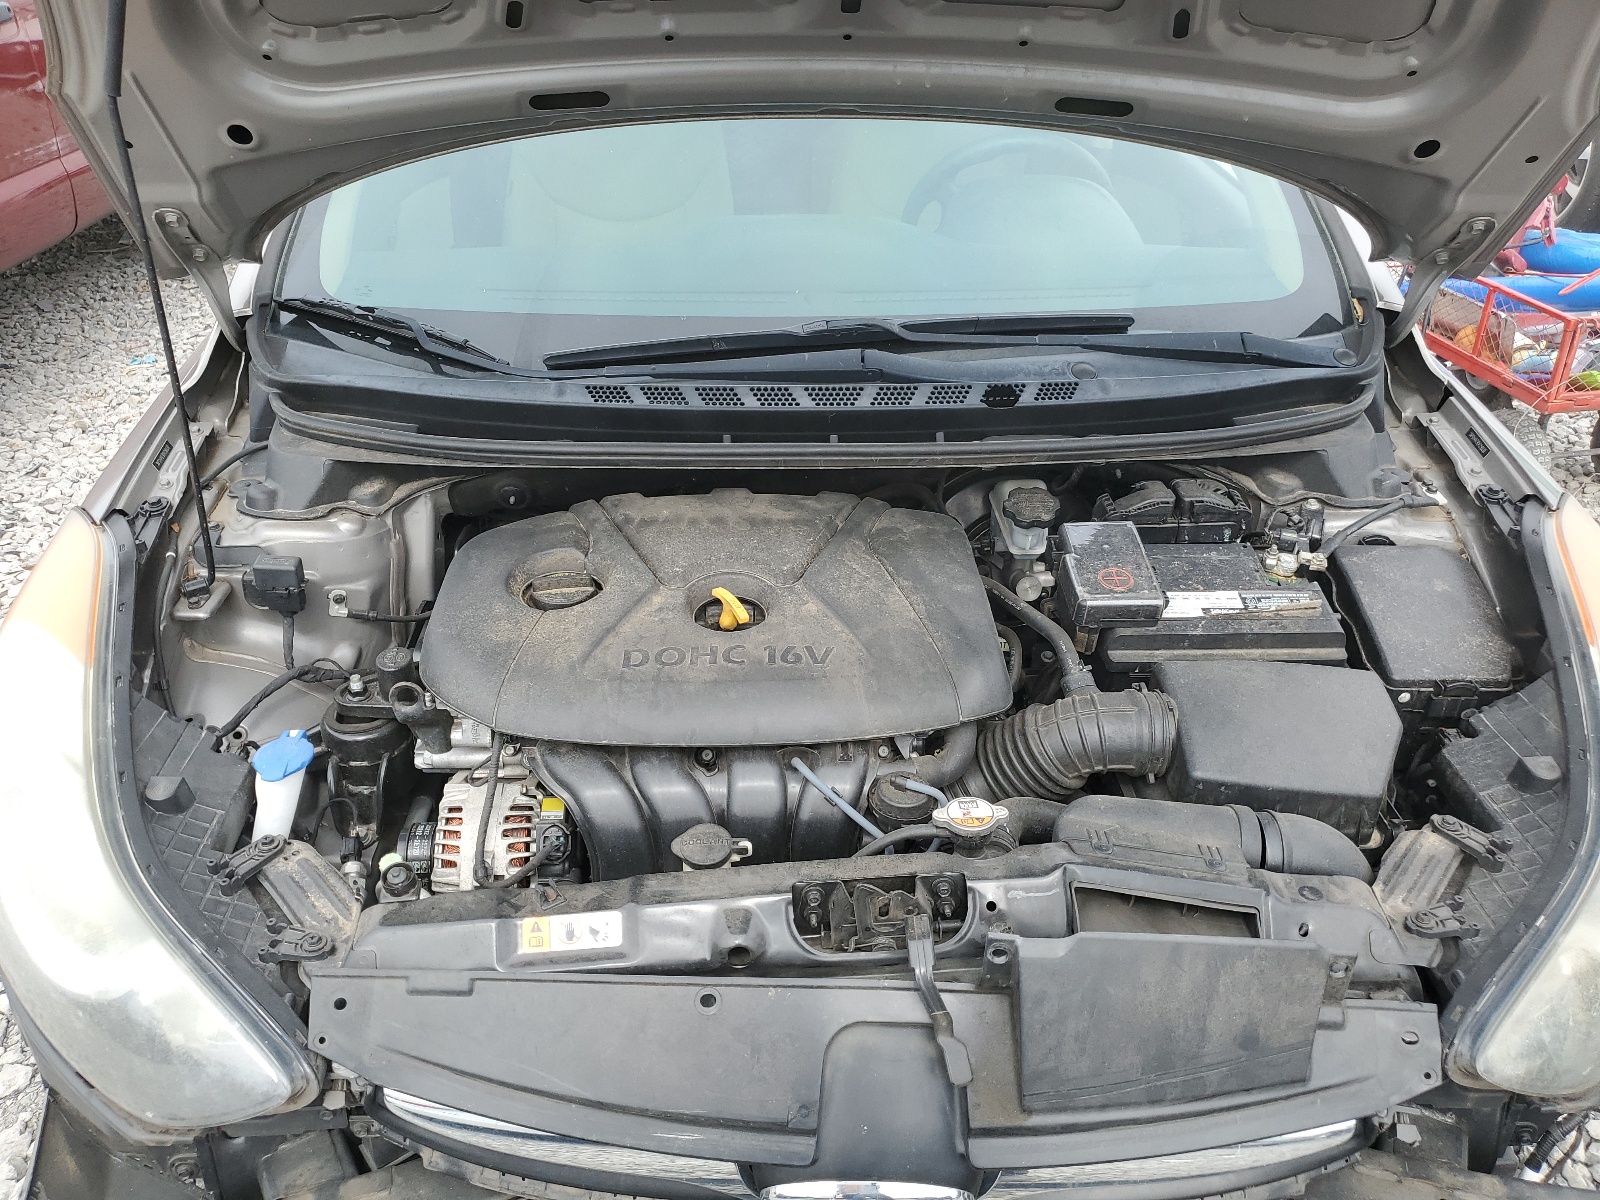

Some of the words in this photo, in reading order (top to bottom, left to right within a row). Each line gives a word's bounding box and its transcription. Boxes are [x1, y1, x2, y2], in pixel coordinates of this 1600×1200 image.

[622, 645, 747, 669] DOHC
[763, 645, 835, 667] 16V
[681, 838, 731, 846] COOLANT
